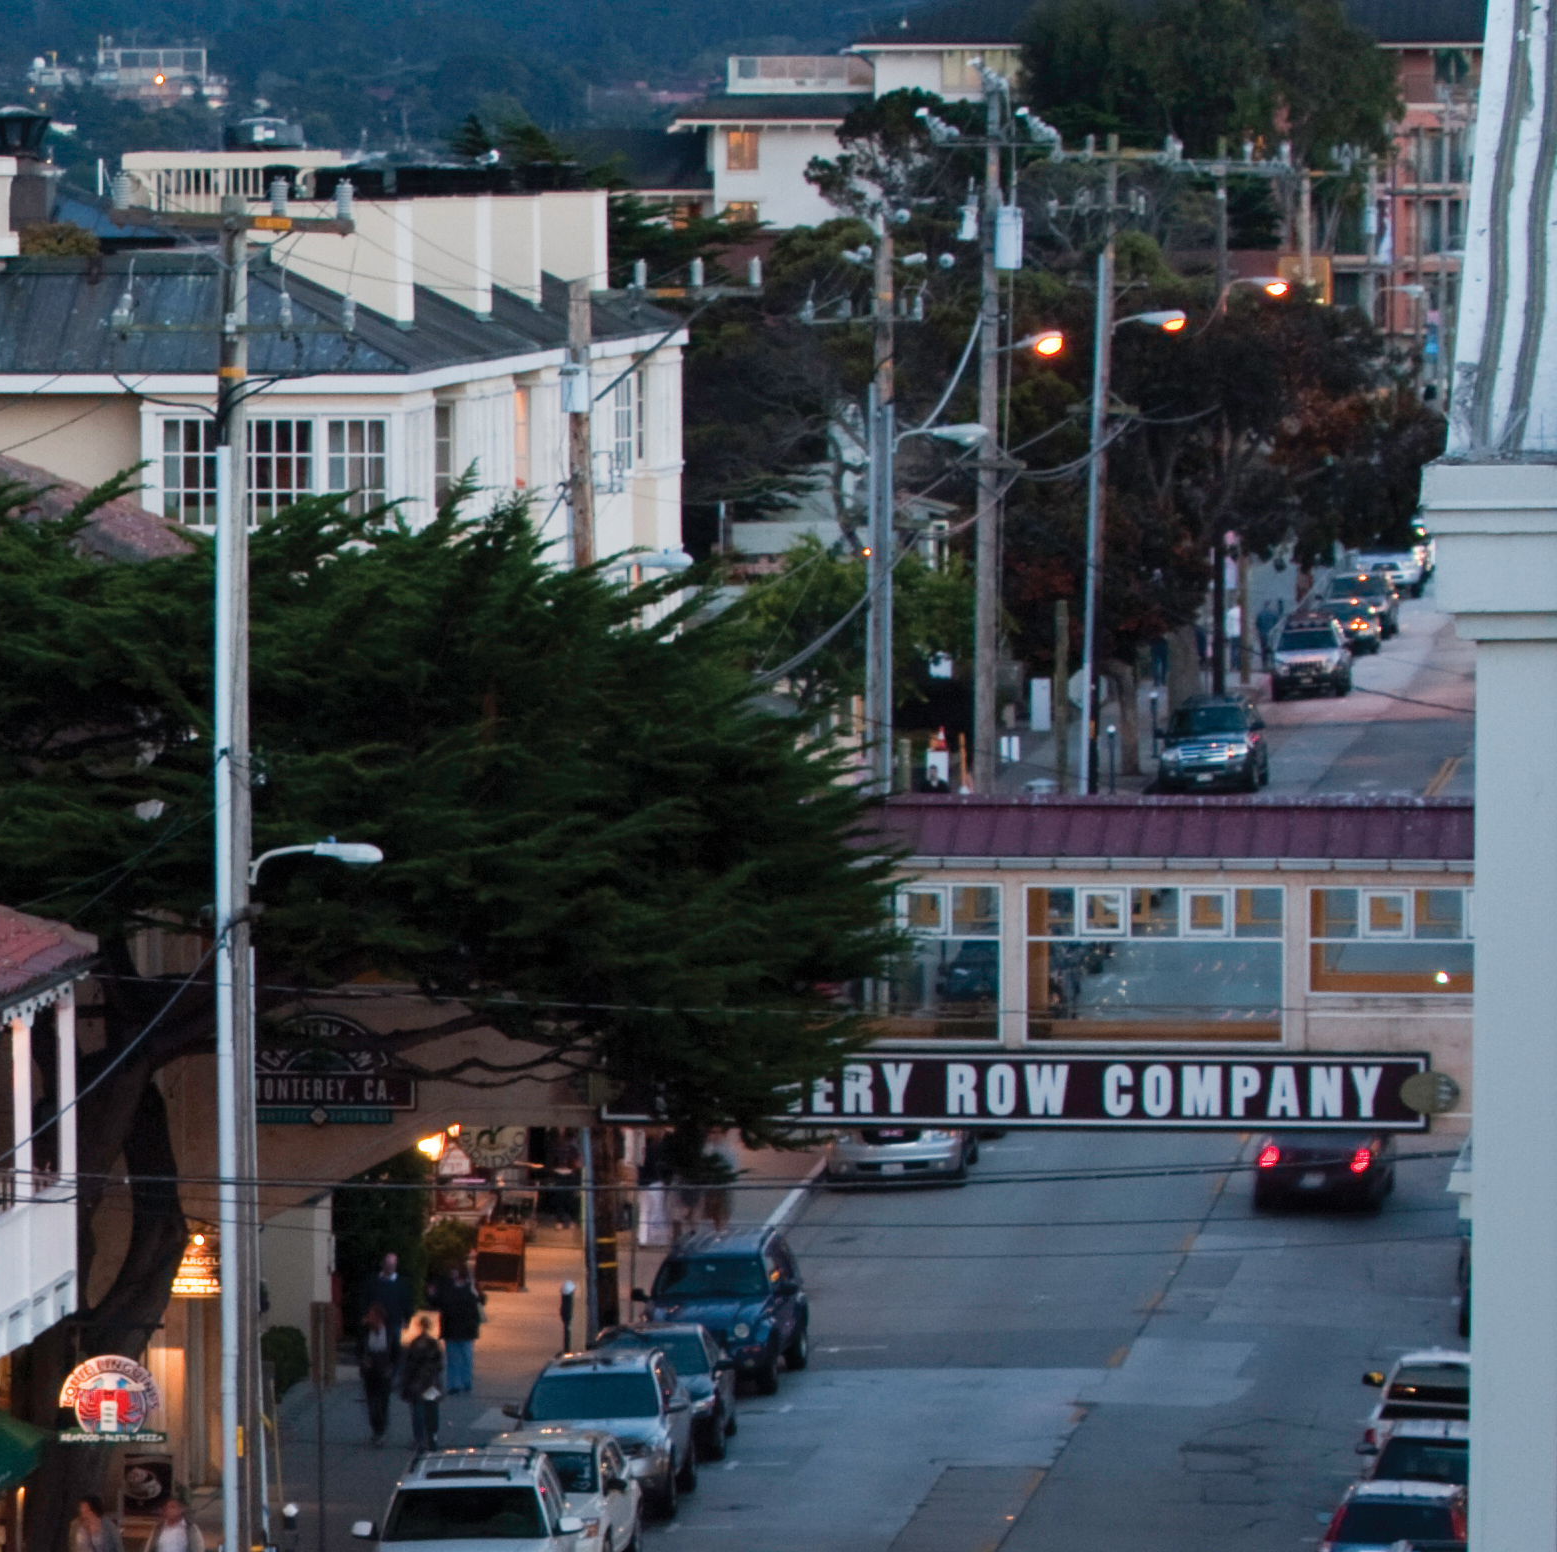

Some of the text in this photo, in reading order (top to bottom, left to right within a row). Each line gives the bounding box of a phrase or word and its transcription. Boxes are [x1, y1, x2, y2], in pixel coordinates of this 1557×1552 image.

[363, 1078, 395, 1101] CA.
[946, 1064, 1070, 1116] ROW
[1103, 1065, 1383, 1118] COMPANY
